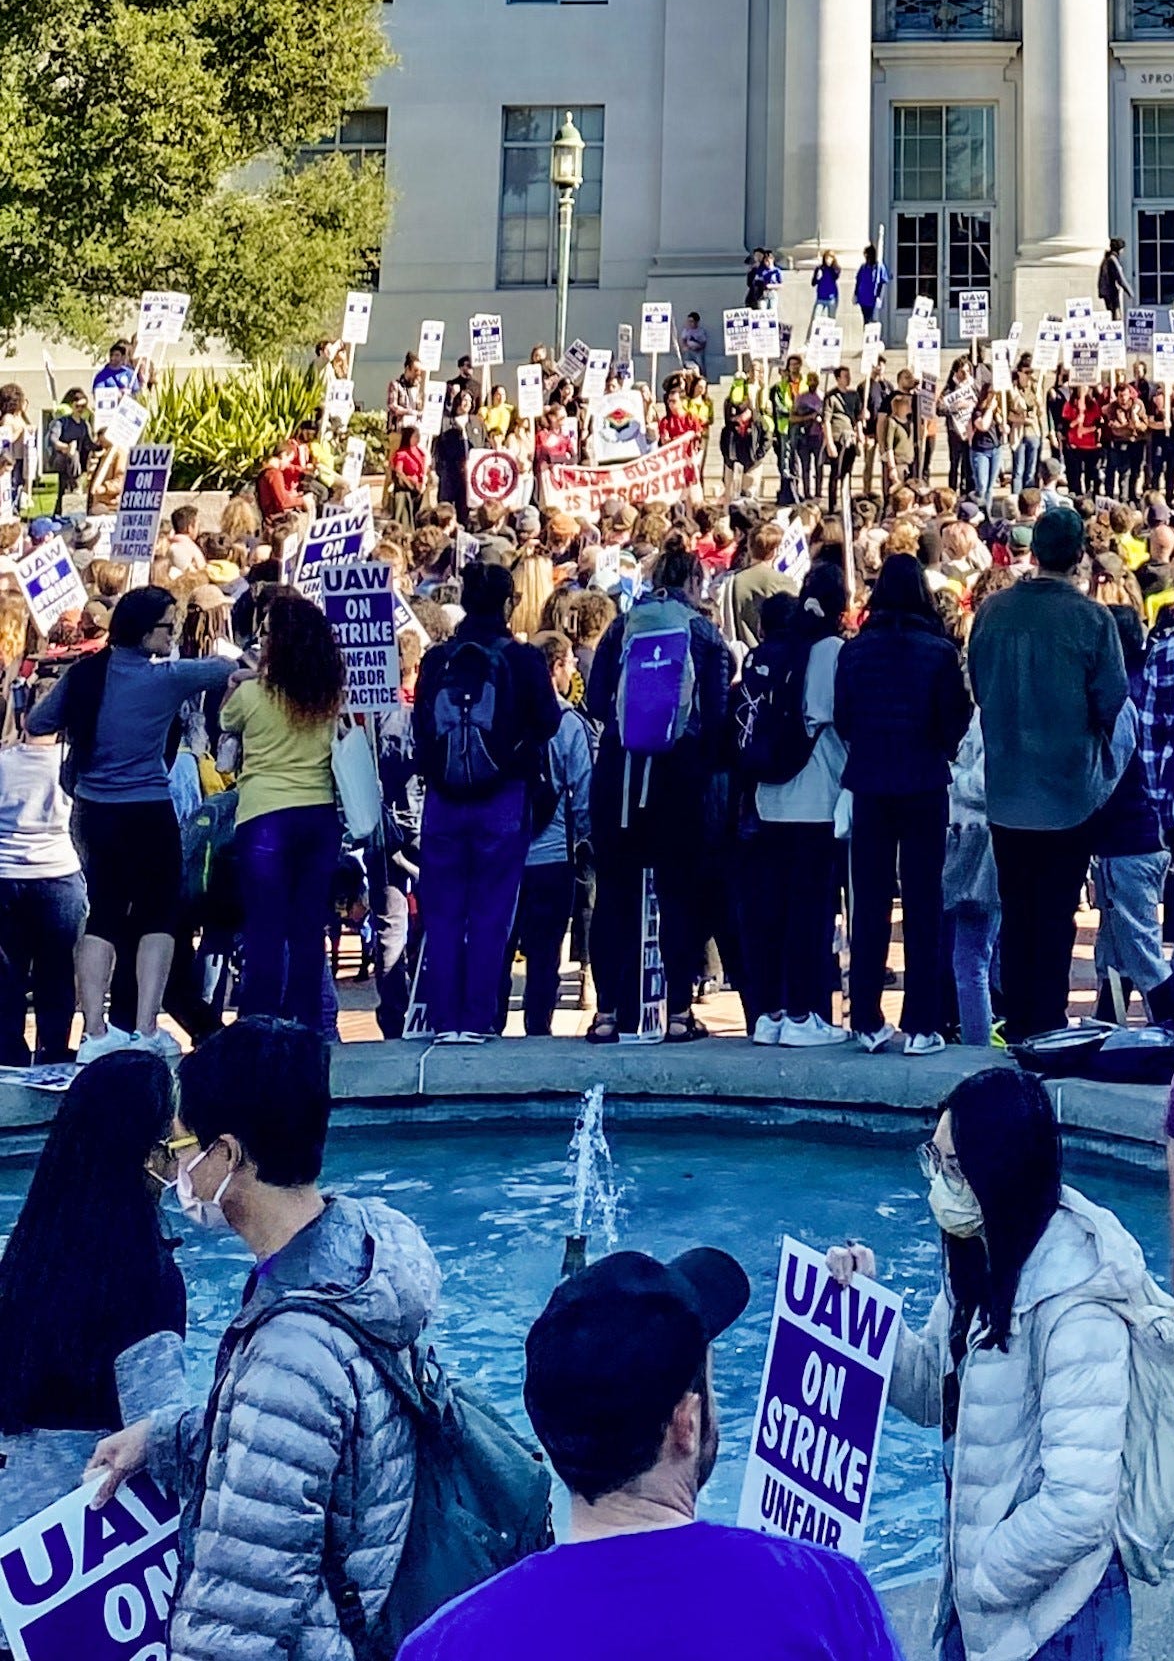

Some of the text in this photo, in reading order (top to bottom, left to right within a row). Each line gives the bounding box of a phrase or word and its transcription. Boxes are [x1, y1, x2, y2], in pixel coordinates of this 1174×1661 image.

[472, 318, 499, 327] UAW
[129, 449, 171, 466] UAW
[623, 440, 692, 480] BUSTIN
[135, 473, 154, 489] ON
[564, 463, 698, 512] IS DISGUSTIN
[121, 492, 162, 508] STRIKE
[122, 514, 152, 526] UNFAIR
[309, 515, 368, 539] UAW
[121, 529, 149, 540] LABOR
[112, 543, 153, 556] PRACTICE
[321, 539, 346, 558] ON
[19, 543, 62, 579] UAW
[41, 568, 61, 589] ON
[324, 566, 390, 591] UAW
[345, 598, 371, 619] ON
[347, 650, 387, 667] NFAIR
[350, 670, 385, 686] ABOR
[344, 688, 399, 705] ACTICE
[785, 1253, 896, 1361] UAW
[802, 1350, 847, 1420] ON
[762, 1395, 867, 1504] STRIKE
[761, 1473, 842, 1550] UNFAIR
[104, 1548, 181, 1643] ON
